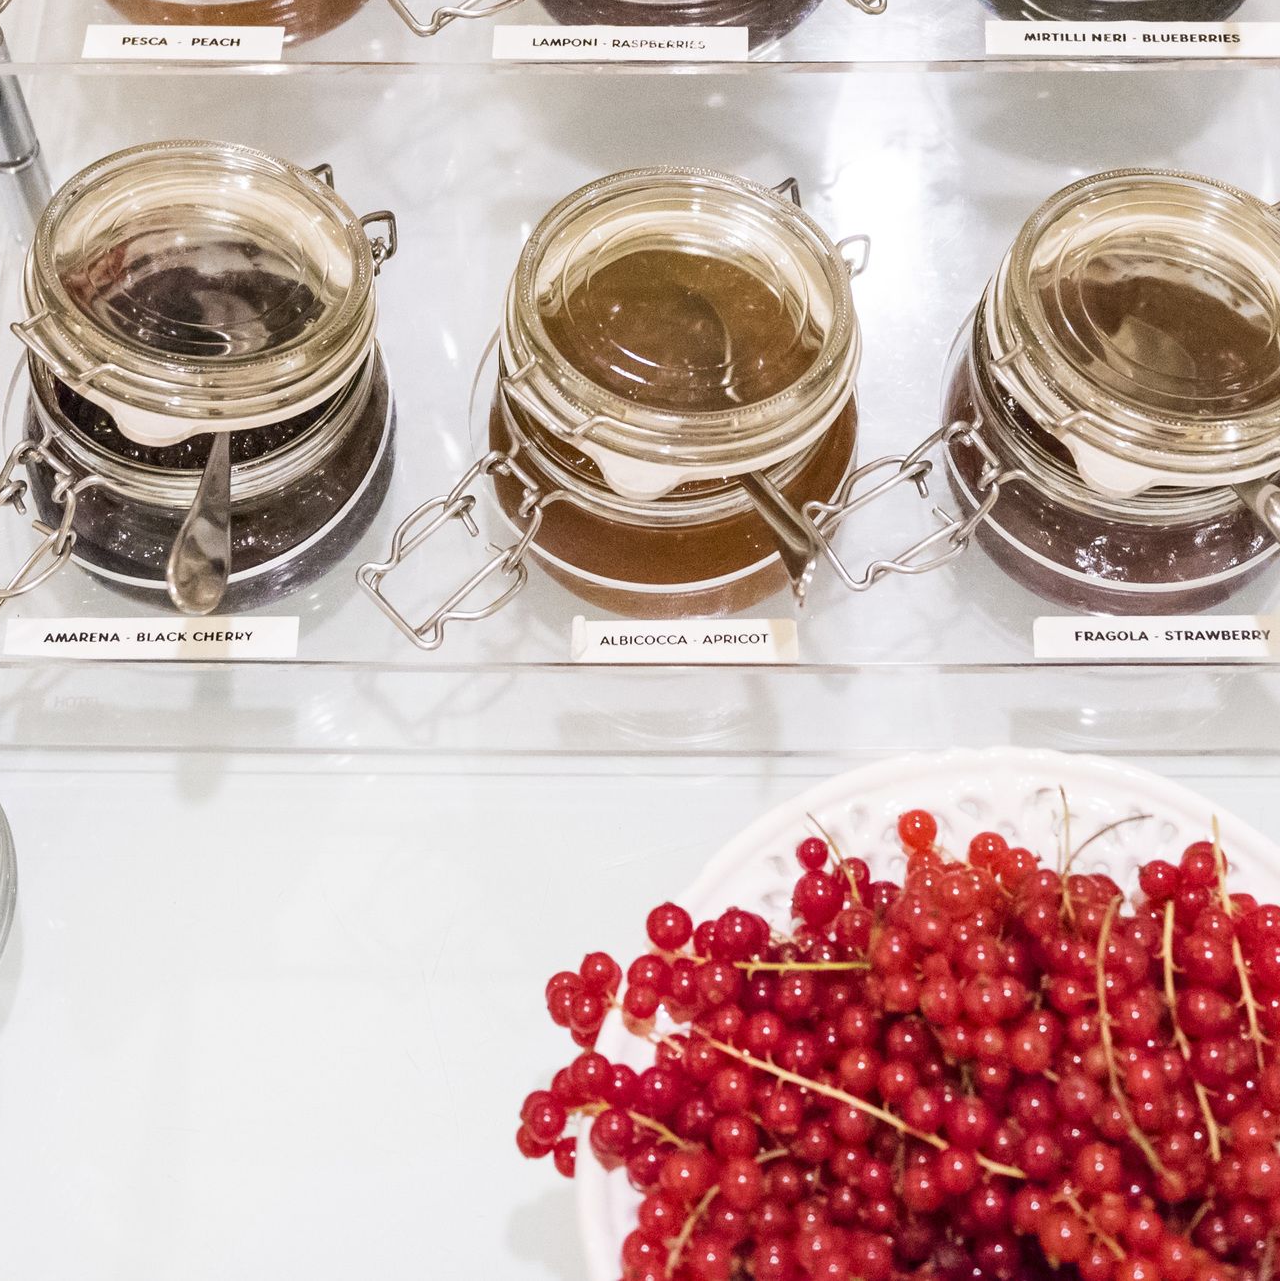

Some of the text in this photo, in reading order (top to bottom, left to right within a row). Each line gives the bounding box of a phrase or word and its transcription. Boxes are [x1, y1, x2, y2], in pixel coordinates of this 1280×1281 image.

[121, 36, 168, 46] PESCA
[191, 37, 241, 47] PEACH
[532, 37, 598, 47] LAMPONI
[611, 39, 706, 50] RASPBERRIES
[1024, 32, 1086, 42] MIRTILLI
[1091, 32, 1127, 42] NERI
[1142, 33, 1241, 43] BLUEBERRIES
[43, 632, 121, 643] AMARENA
[136, 631, 188, 642] BLACK
[192, 631, 254, 642] CHERRY
[599, 635, 688, 646] ALBICOCCA
[702, 633, 769, 644] APRICOT
[1074, 630, 1149, 642] FRAGOLA
[1165, 629, 1271, 642] STRAWBERRY
